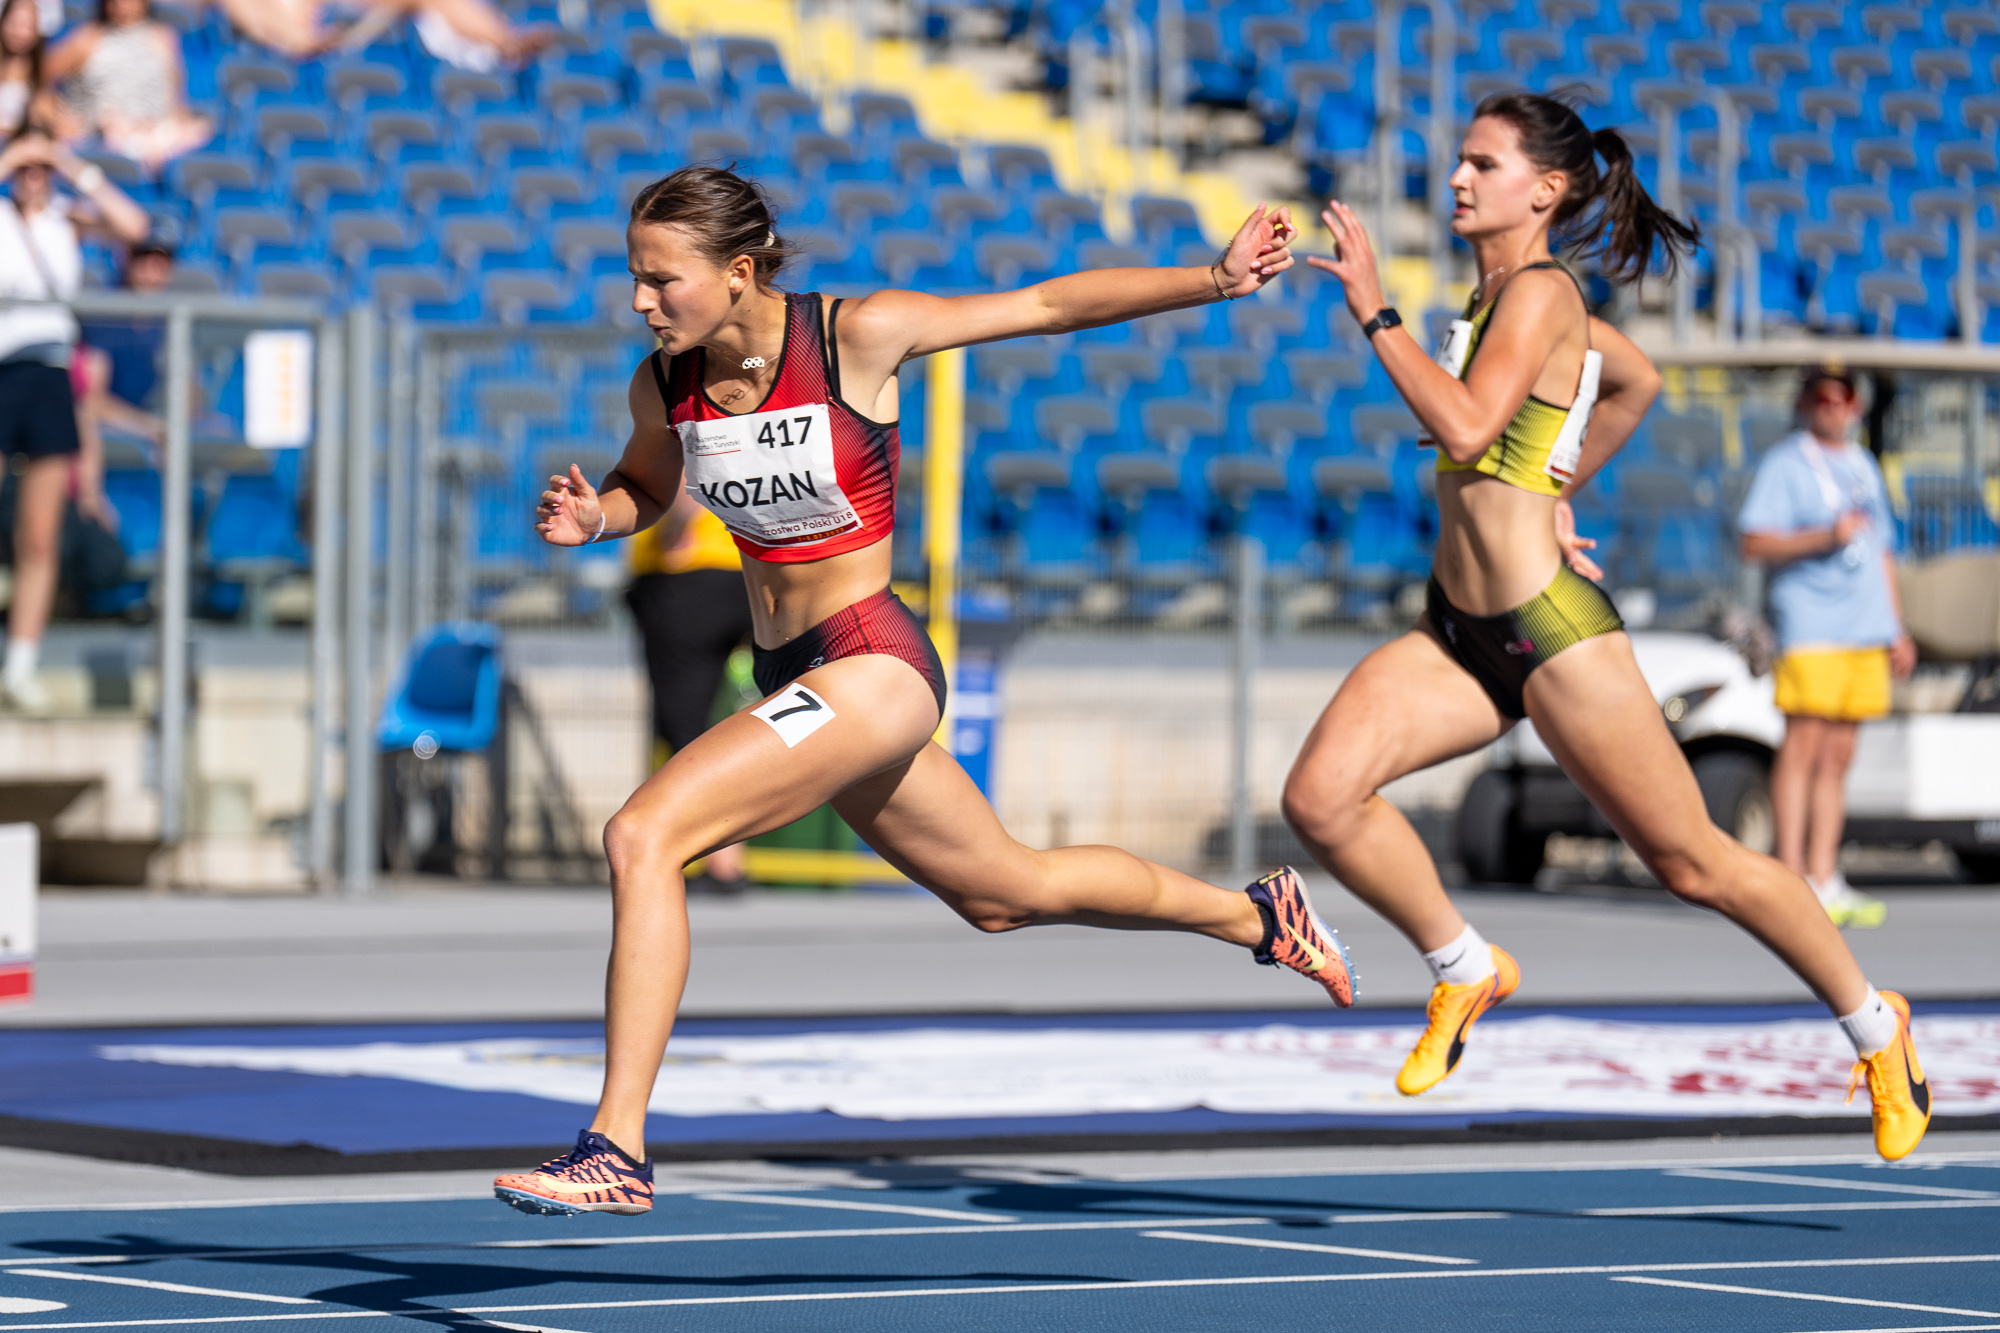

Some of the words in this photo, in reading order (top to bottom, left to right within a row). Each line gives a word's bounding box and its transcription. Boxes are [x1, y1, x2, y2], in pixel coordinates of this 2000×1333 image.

[757, 415, 813, 449] 417
[699, 470, 819, 509] KOZAN
[803, 517, 832, 531] Polski
[832, 511, 854, 525] U18
[768, 690, 823, 722] 7
